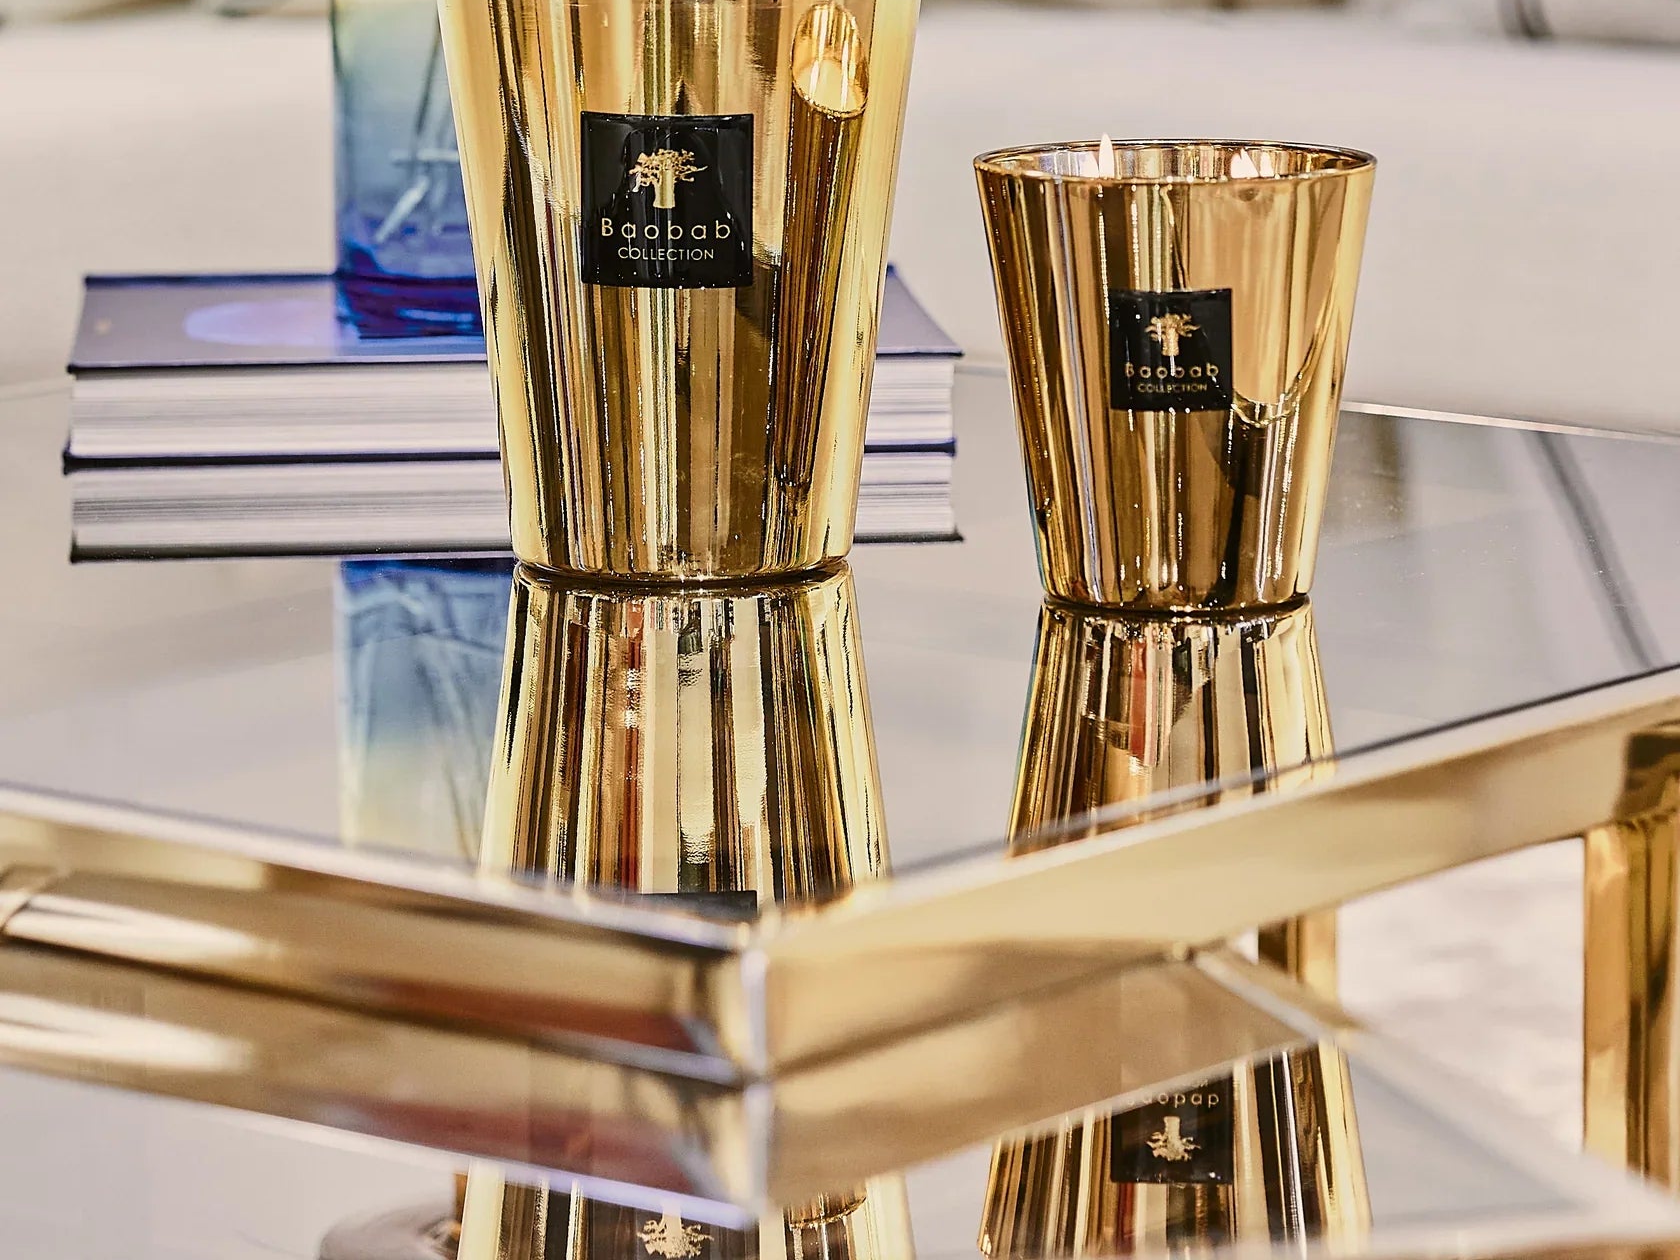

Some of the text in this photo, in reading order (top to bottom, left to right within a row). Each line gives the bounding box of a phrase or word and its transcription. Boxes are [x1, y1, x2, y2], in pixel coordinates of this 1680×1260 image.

[601, 217, 731, 240] Baobab
[617, 246, 714, 261] COLLECTION
[1125, 362, 1219, 378] Baobab
